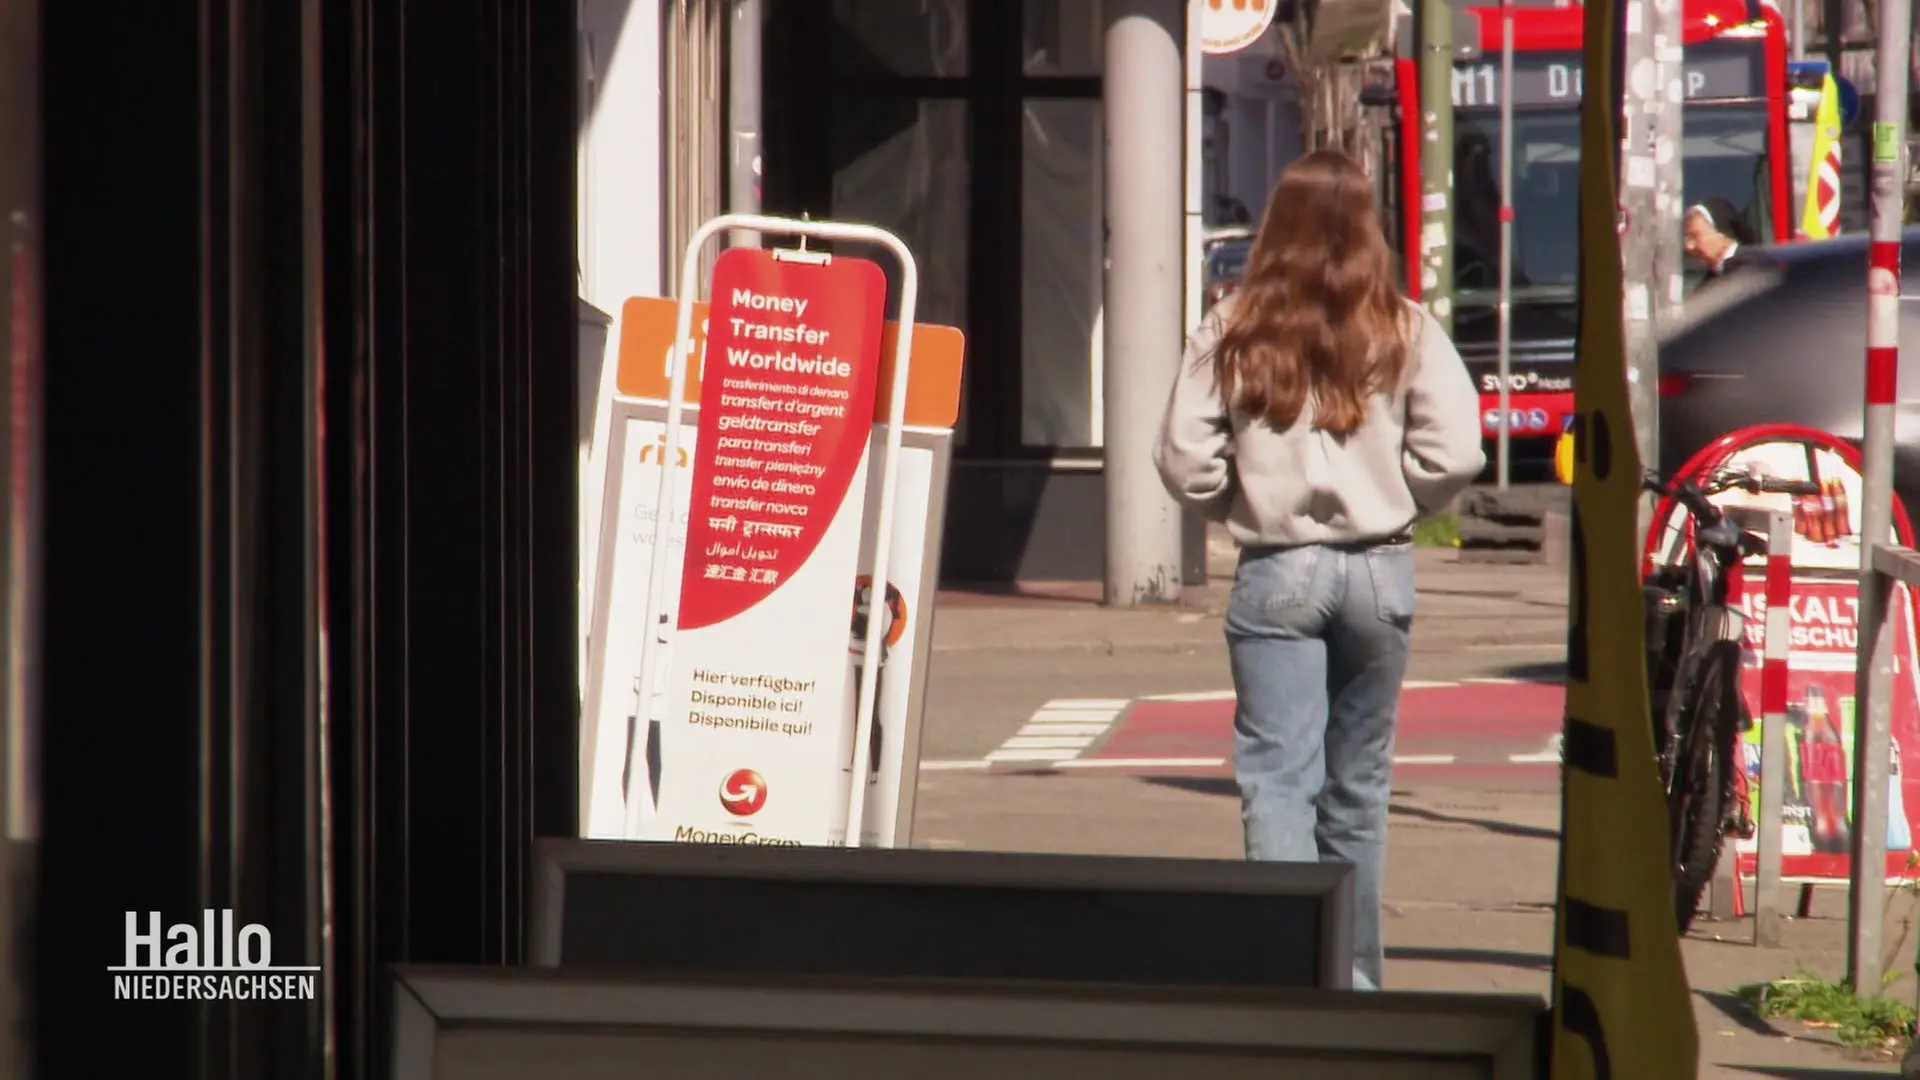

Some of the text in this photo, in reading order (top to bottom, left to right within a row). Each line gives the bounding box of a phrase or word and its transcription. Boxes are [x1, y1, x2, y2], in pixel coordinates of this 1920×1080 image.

[732, 287, 808, 317] Money
[730, 317, 830, 346] Transfer
[727, 346, 851, 377] Worldwide
[723, 377, 849, 400] trasferimento di denaro
[721, 394, 846, 418] transfert d'argent
[718, 414, 822, 437] geldtransfer
[717, 436, 812, 456] para transferi
[715, 454, 763, 470] transfer
[751, 476, 769, 491] de
[771, 479, 816, 496] dinero
[710, 495, 808, 517] transfer novca
[692, 668, 816, 694] Hier verfügbar!
[690, 690, 803, 713] Disponible ici!
[688, 711, 813, 737] Disponibile qui!
